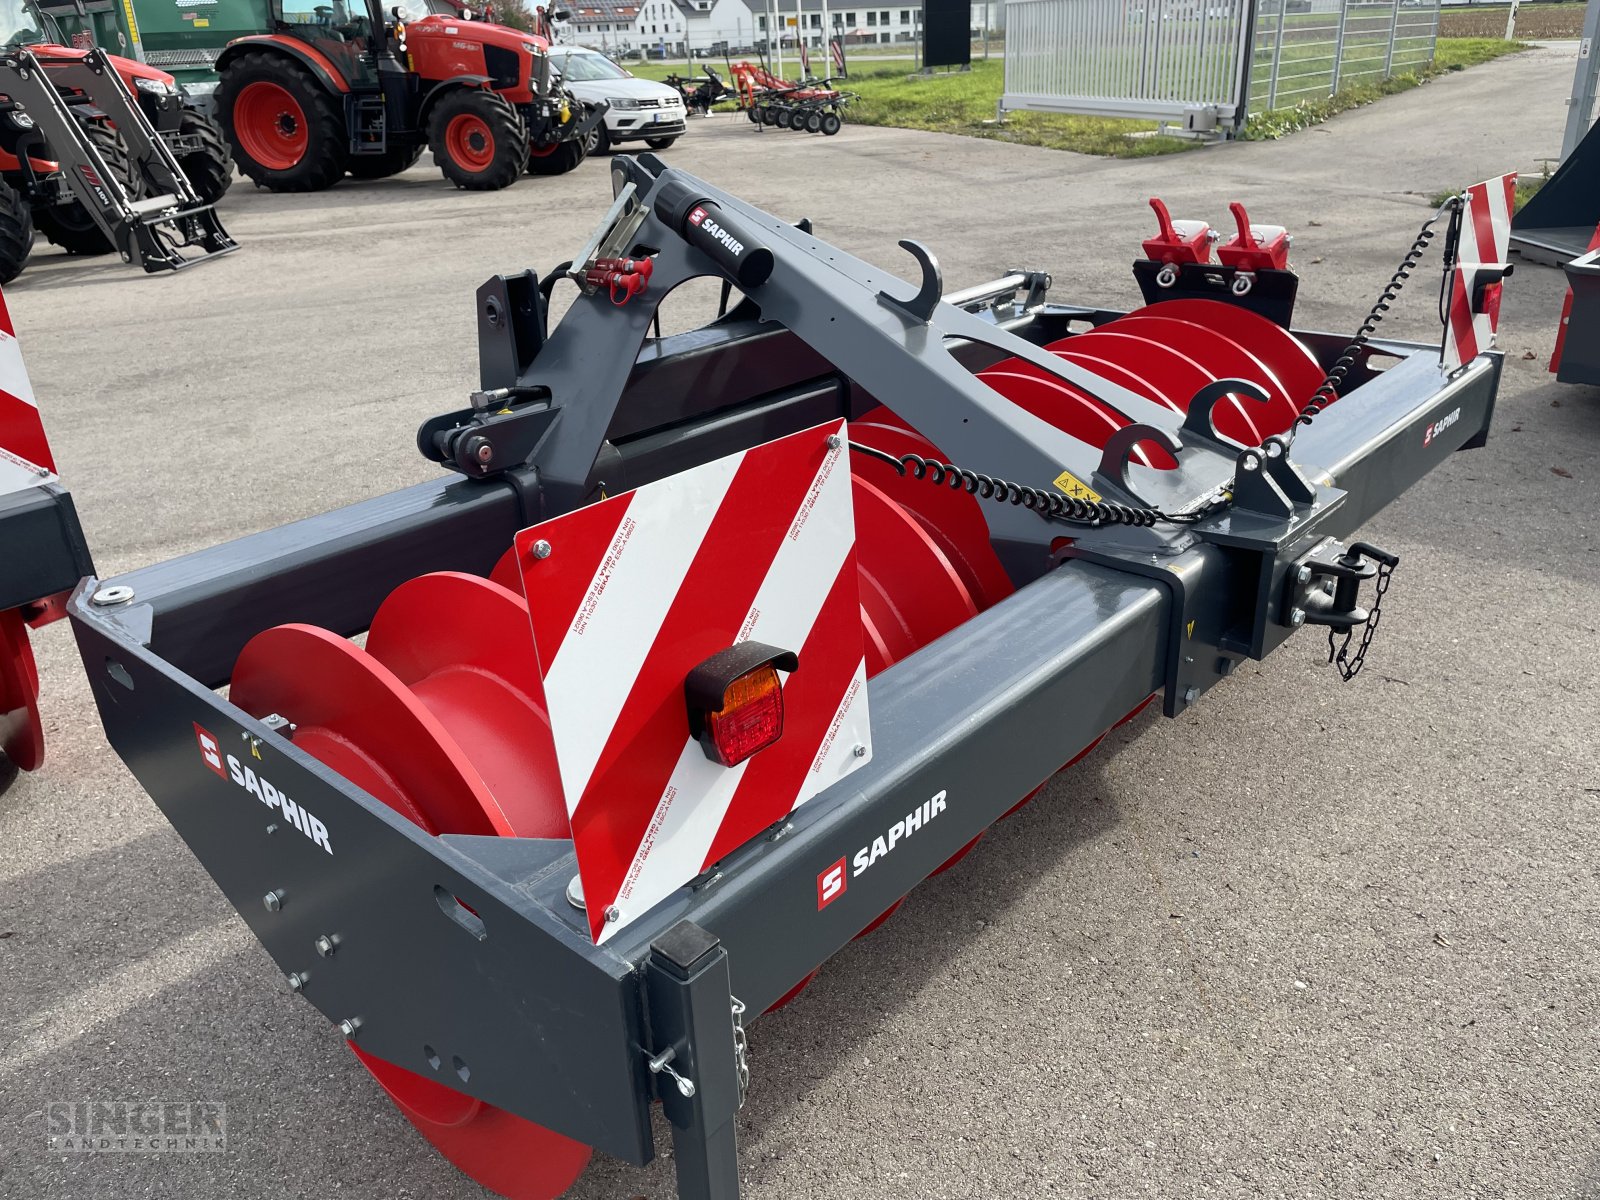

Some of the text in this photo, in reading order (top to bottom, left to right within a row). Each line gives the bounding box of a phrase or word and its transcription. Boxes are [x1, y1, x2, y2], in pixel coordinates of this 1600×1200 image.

[702, 218, 744, 256] SAPHIR
[1432, 407, 1460, 438] SAPHIR
[622, 517, 631, 531] DIN
[612, 532, 624, 551] 11030
[599, 556, 612, 576] GEKA
[594, 582, 600, 591] TP
[578, 621, 587, 635] DIN
[586, 600, 597, 619] 11030
[597, 575, 610, 595] GEKA
[609, 560, 616, 568] TP
[227, 754, 333, 856] SAPHIR
[644, 824, 656, 843] GEKA
[853, 790, 947, 877] SAPHIR
[642, 841, 654, 860] GEKA
